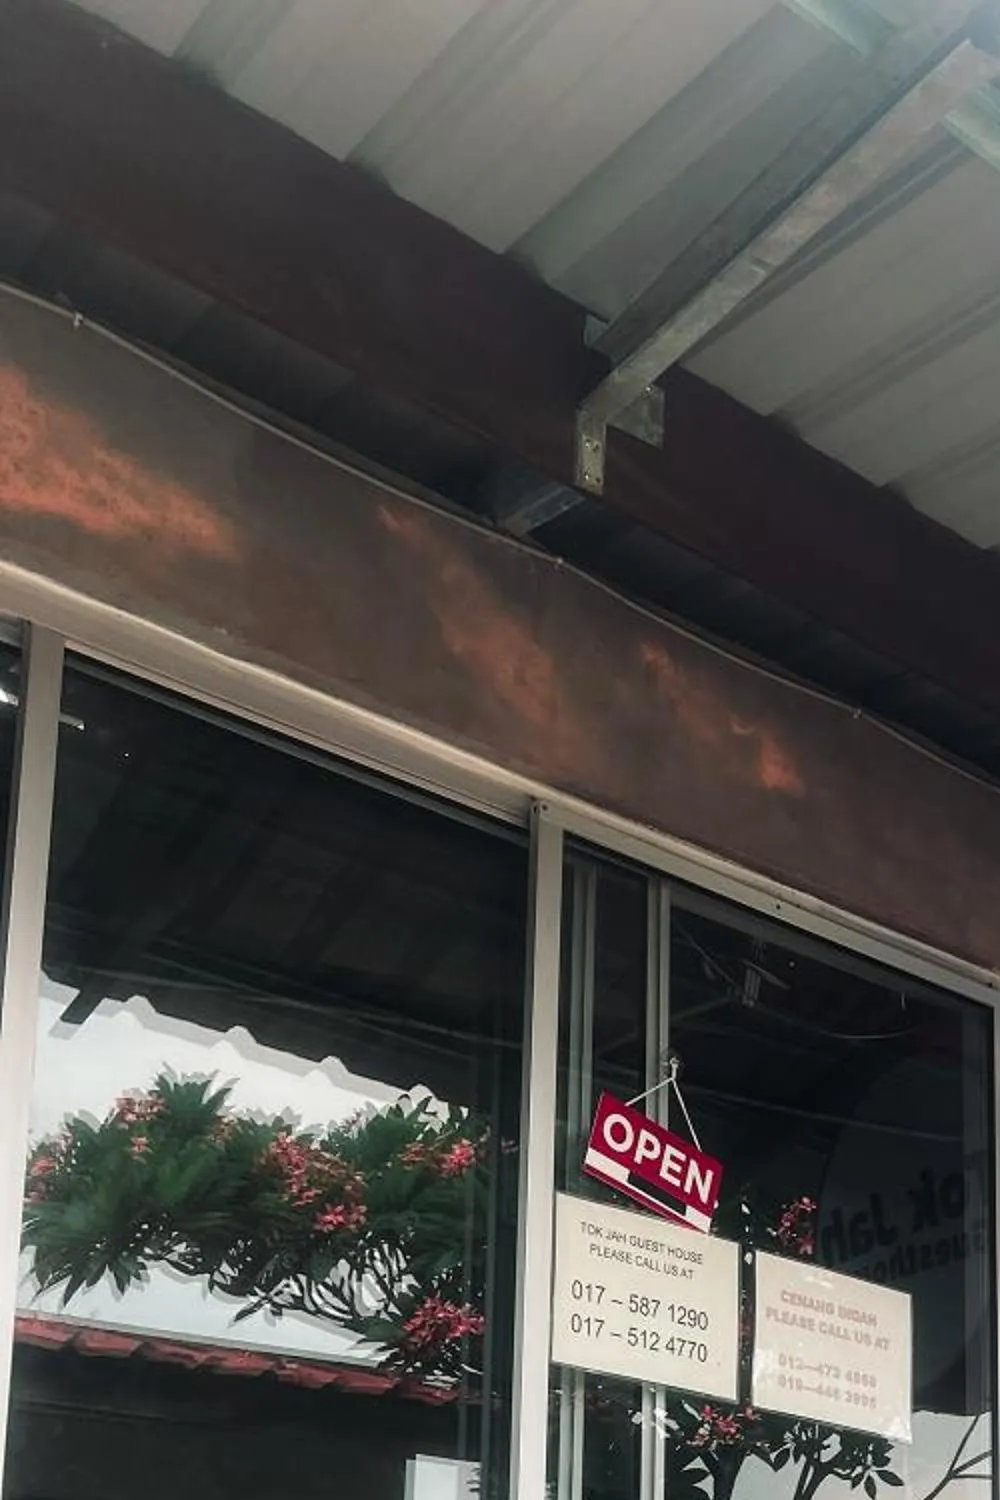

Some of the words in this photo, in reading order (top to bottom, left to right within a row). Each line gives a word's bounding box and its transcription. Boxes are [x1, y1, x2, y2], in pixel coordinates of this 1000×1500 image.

[602, 1113, 713, 1205] OPEN
[580, 1221, 602, 1238] TOK
[605, 1229, 626, 1244] JAH
[629, 1235, 665, 1253] GUEST
[667, 1246, 704, 1265] HOUSE
[589, 1243, 633, 1264] PLEASE
[635, 1255, 661, 1273] CALL
[663, 1263, 678, 1277] US
[680, 1268, 694, 1280] AT
[571, 1279, 606, 1305] 017
[629, 1293, 661, 1318] 587
[667, 1304, 709, 1330] 1290
[571, 1313, 605, 1338] 017
[627, 1327, 660, 1351] 512
[665, 1337, 708, 1363] 4770
[765, 1306, 816, 1332] PLEASE
[819, 1320, 851, 1341] CALL
[854, 1331, 872, 1347] US
[874, 1338, 890, 1351] AT
